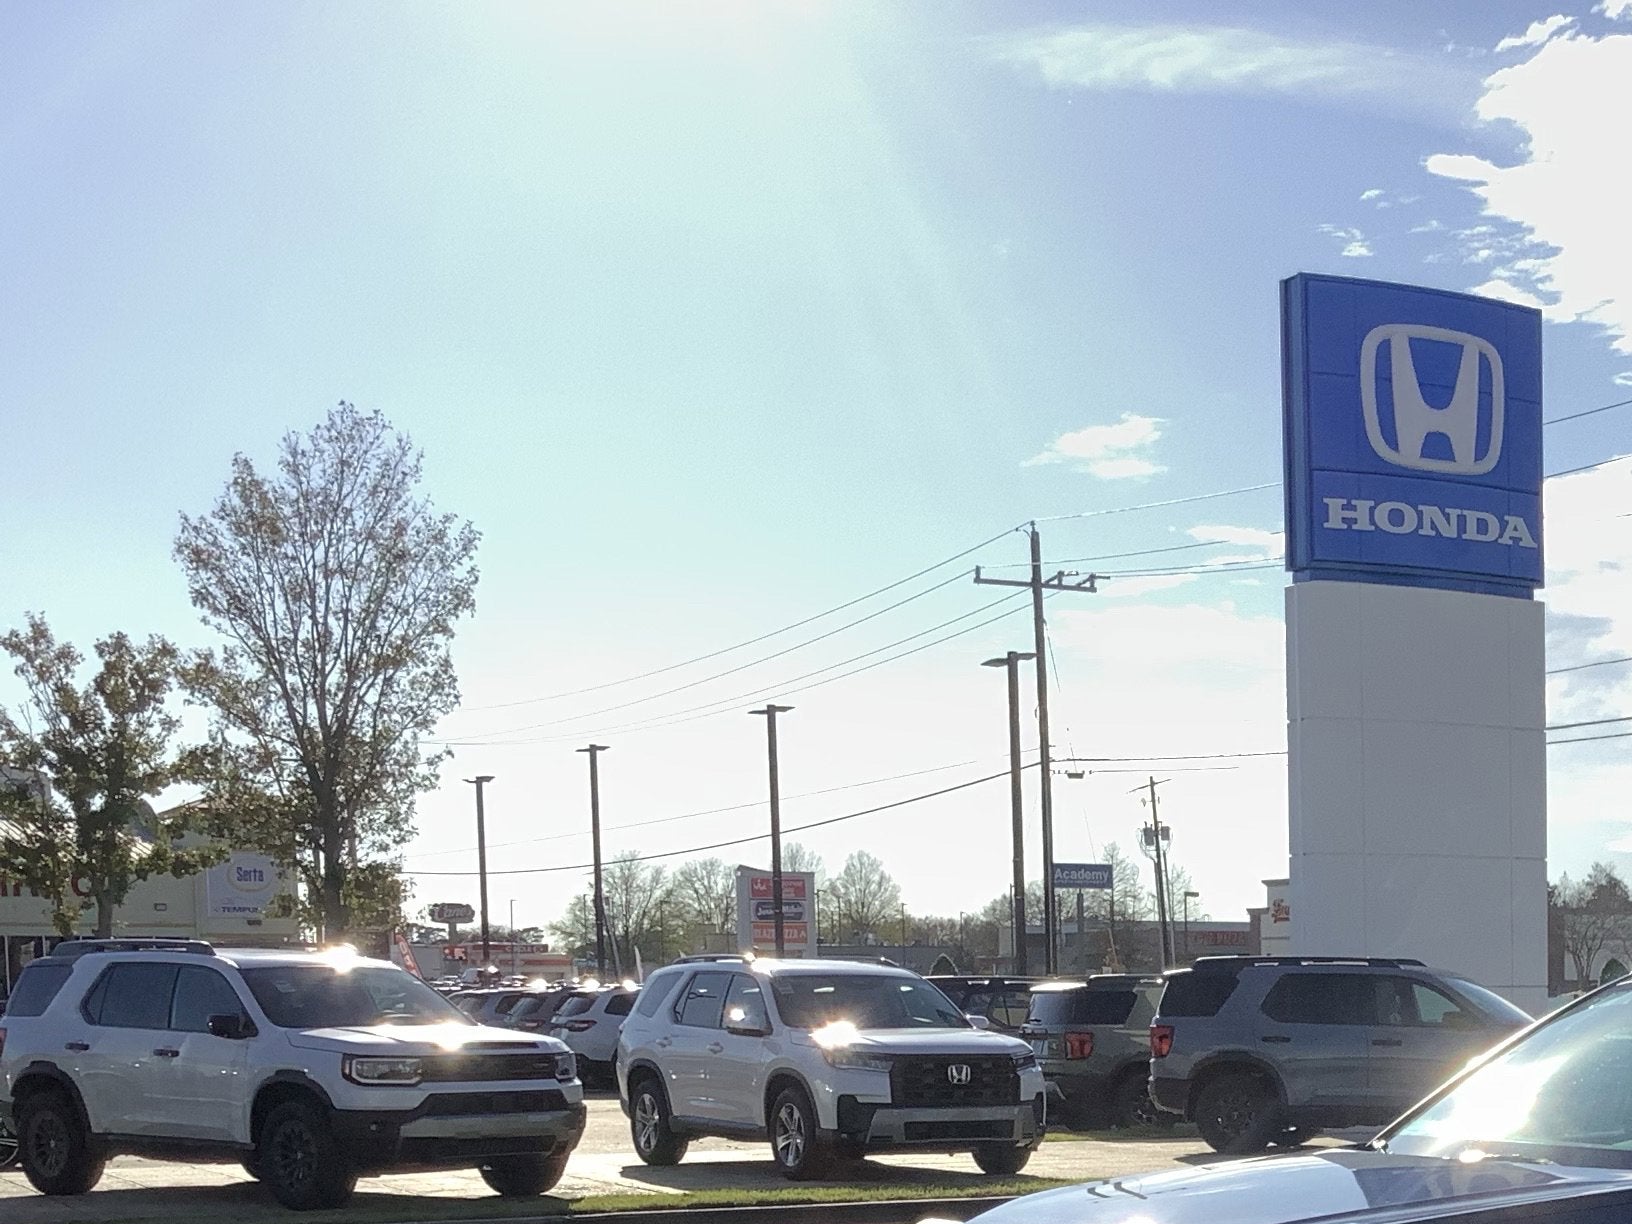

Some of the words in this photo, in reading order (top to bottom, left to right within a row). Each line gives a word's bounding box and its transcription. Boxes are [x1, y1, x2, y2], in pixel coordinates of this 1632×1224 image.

[1323, 498, 1537, 548] HONDA
[236, 866, 264, 882] Serta
[1055, 868, 1108, 883] Academy
